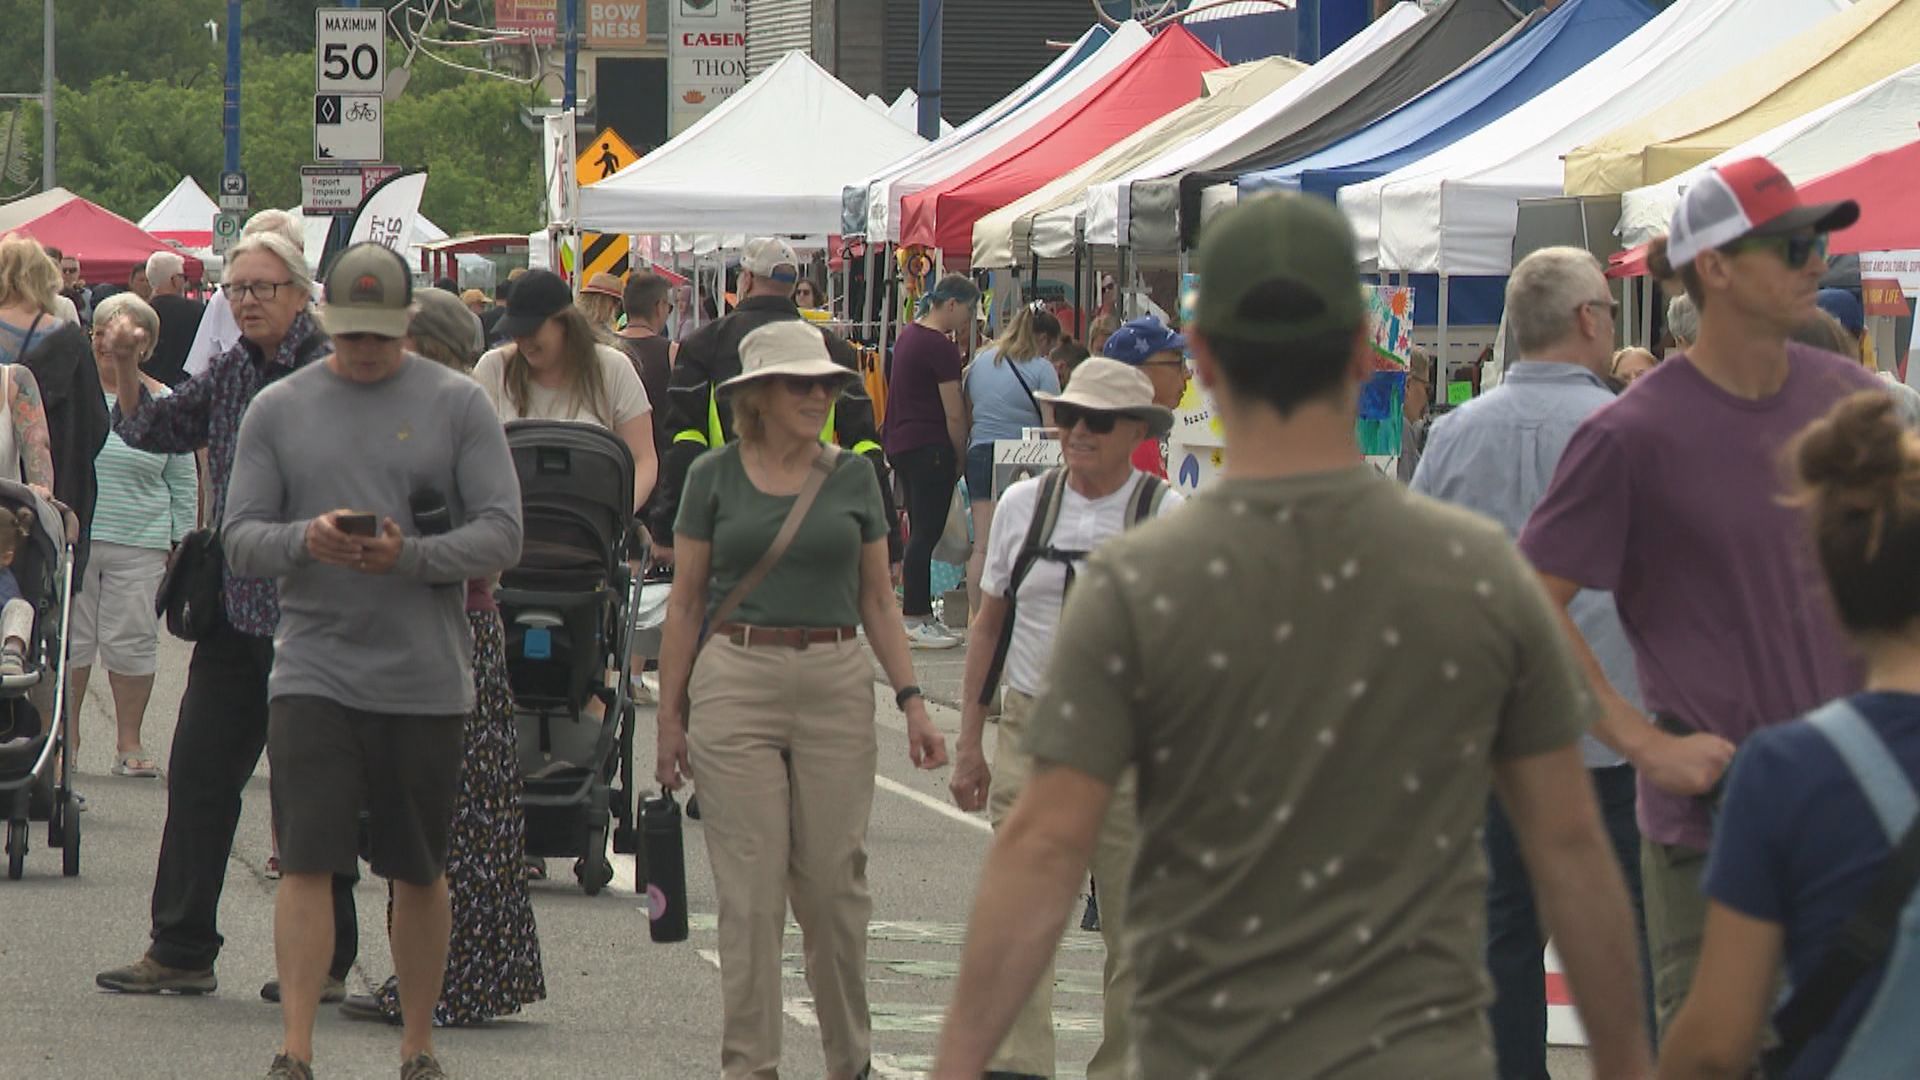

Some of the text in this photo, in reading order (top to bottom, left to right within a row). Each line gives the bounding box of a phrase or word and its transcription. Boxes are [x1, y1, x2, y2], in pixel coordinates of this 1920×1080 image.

[591, 4, 641, 20] BOW
[325, 17, 377, 31] MAXIMUM
[591, 22, 641, 38] NESS
[323, 43, 378, 80] 50
[312, 177, 340, 187] Report
[312, 188, 351, 198] Impaired
[312, 198, 342, 207] Drivers
[222, 221, 231, 233] P
